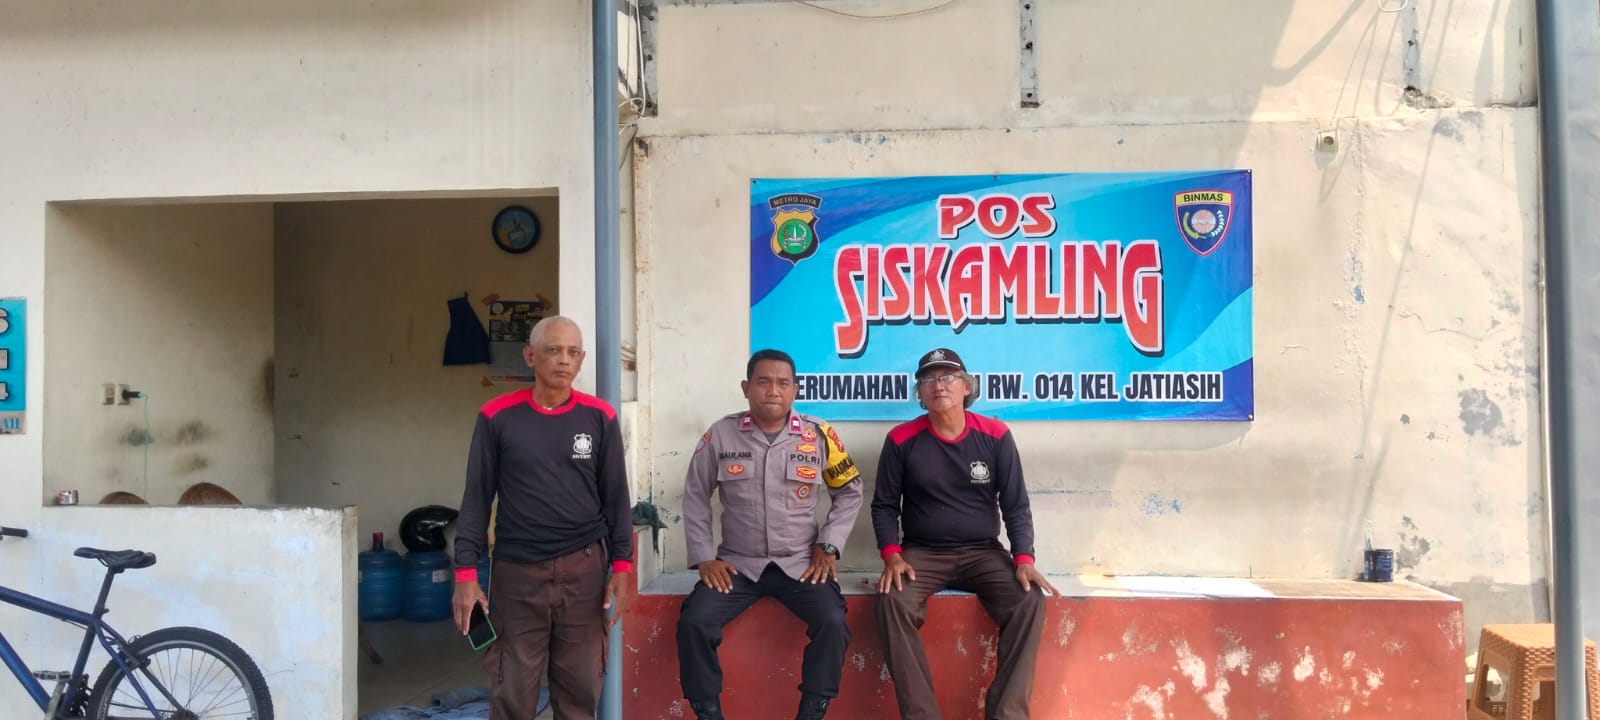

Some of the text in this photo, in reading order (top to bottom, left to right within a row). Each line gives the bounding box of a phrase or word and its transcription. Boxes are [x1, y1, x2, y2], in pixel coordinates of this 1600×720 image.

[773, 196, 816, 206] METRO JAYA
[1183, 193, 1224, 203] BINMAS
[937, 193, 1057, 239] POS
[834, 240, 1163, 357] SISKAMLING
[794, 374, 908, 401] ERUMAHAN
[987, 373, 1028, 400] RW.
[1035, 373, 1074, 400] 014
[1080, 373, 1119, 400] KEL
[1124, 373, 1222, 400] JATIASIH
[789, 453, 820, 464] POLRI
